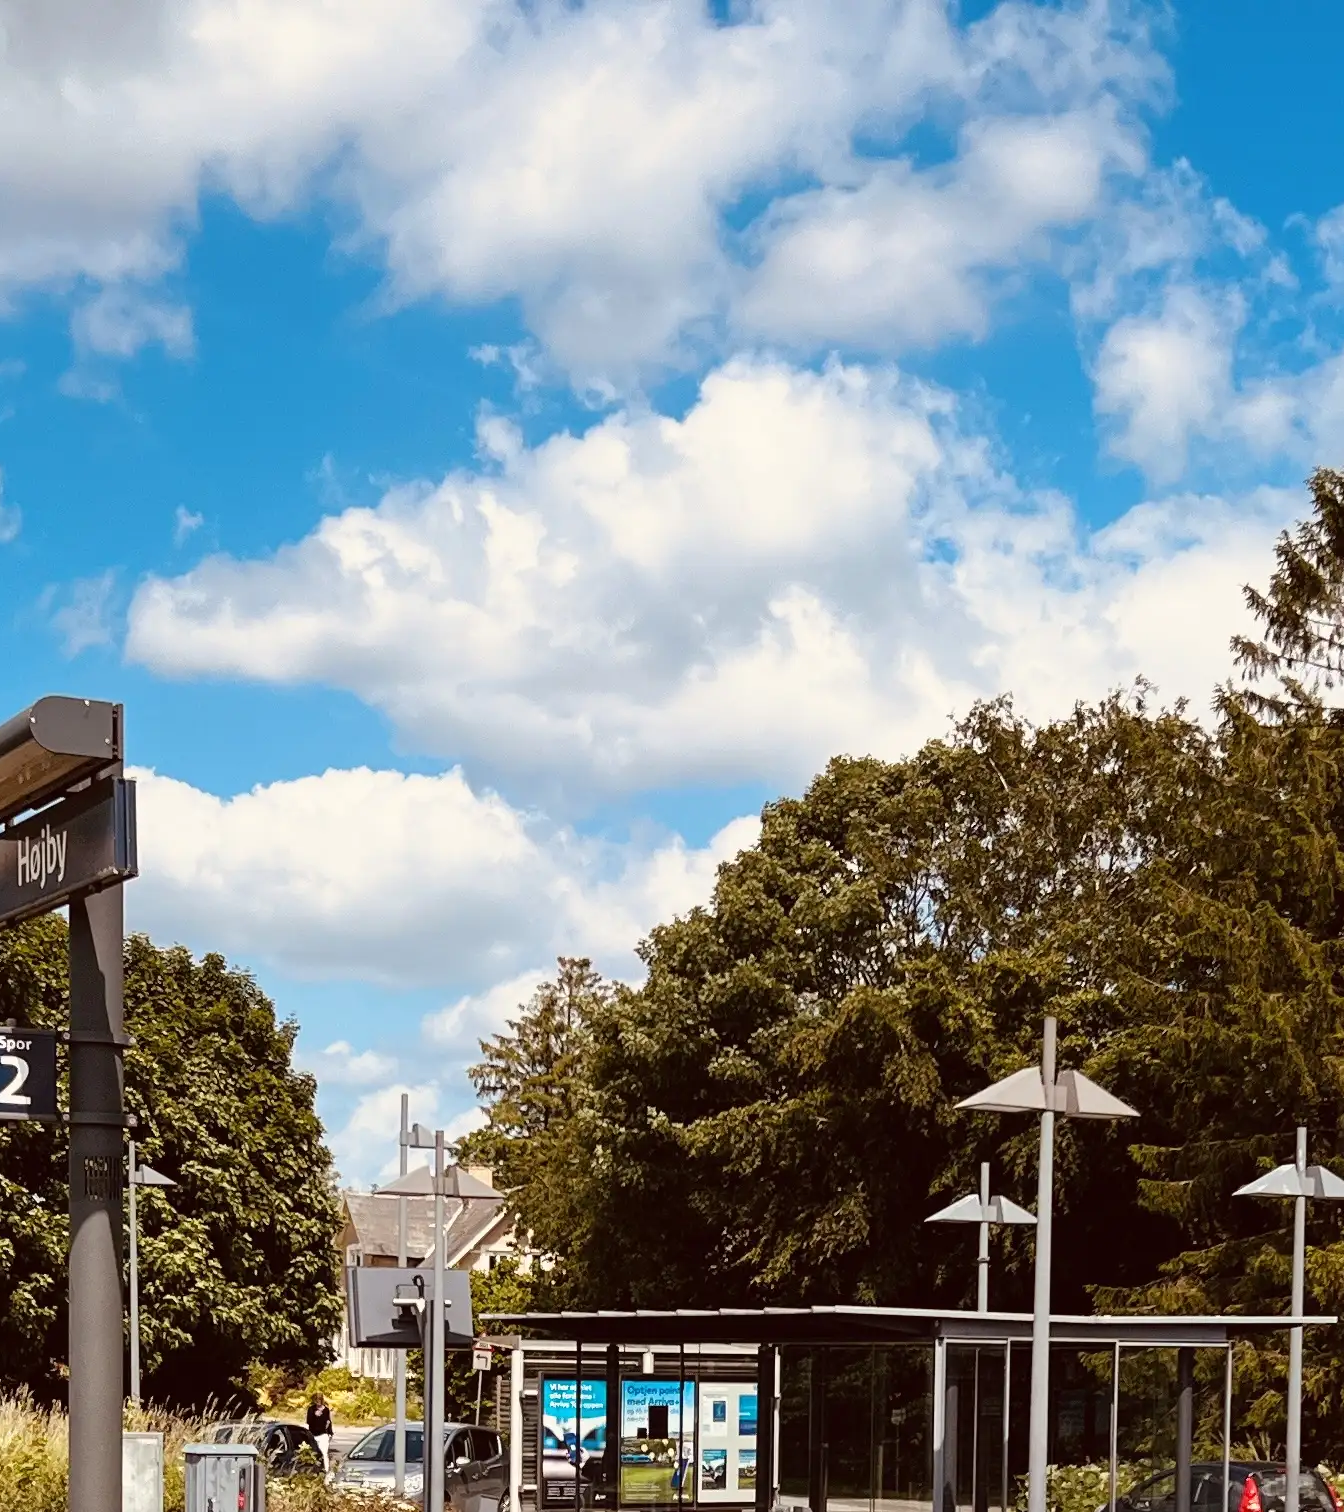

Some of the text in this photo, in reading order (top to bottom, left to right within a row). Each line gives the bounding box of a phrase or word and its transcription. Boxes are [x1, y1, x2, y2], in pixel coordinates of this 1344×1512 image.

[17, 825, 68, 889] Højby
[627, 1386, 657, 1396] Optjen
[627, 1397, 646, 1405] med
